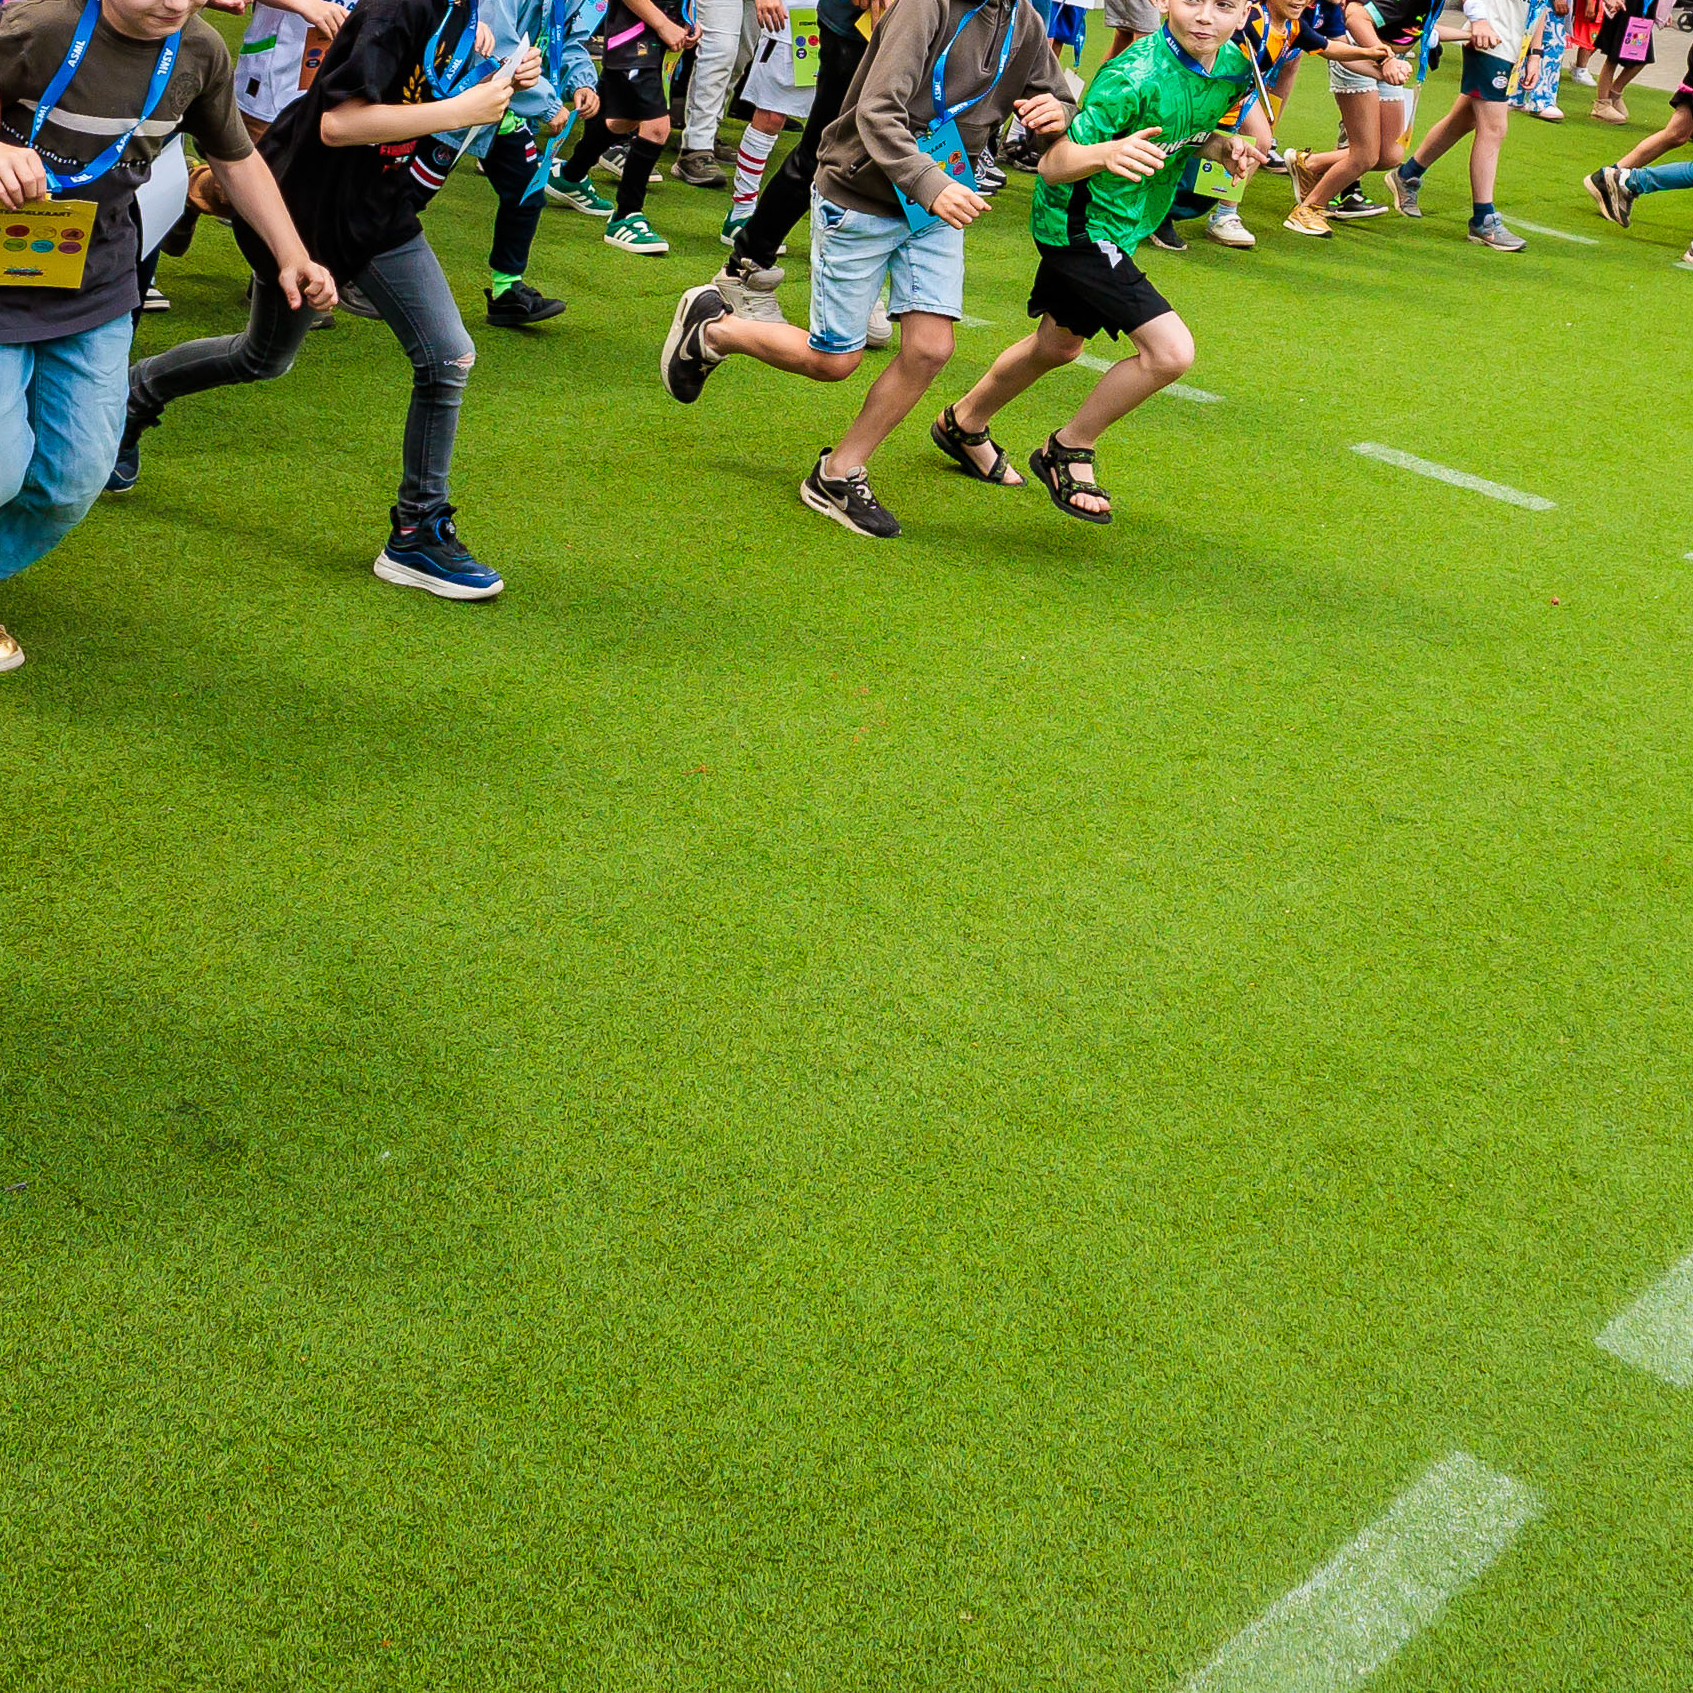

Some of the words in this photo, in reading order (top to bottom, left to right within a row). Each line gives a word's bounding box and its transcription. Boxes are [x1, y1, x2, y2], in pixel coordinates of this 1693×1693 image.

[68, 39, 85, 68] ASML
[1165, 36, 1180, 57] ASML
[157, 47, 173, 76] ASML
[446, 58, 462, 80] ASML
[934, 80, 943, 101] ASML
[35, 104, 50, 132] ASML
